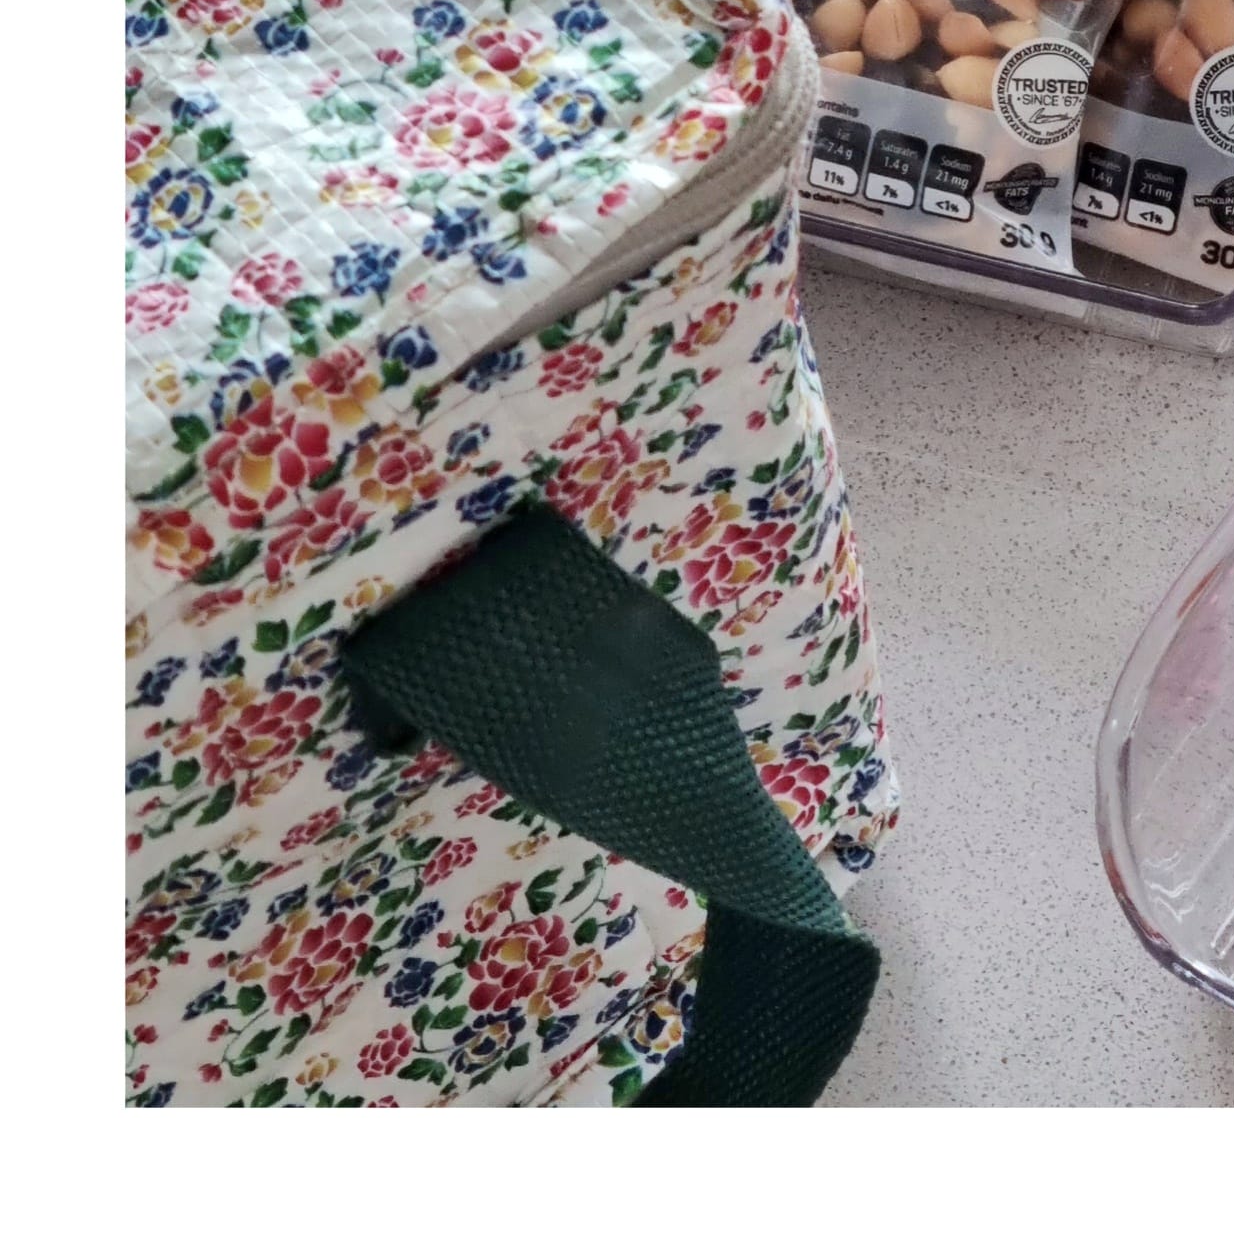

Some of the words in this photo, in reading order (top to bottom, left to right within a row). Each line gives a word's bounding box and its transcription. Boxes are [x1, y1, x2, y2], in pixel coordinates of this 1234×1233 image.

[1011, 78, 1088, 95] TRUSTED
[1022, 94, 1060, 106] SINCE
[823, 169, 845, 186] 11%
[950, 174, 970, 189] mg
[882, 184, 898, 199] 7%
[1154, 187, 1173, 202] mg
[1000, 223, 1035, 248] 30
